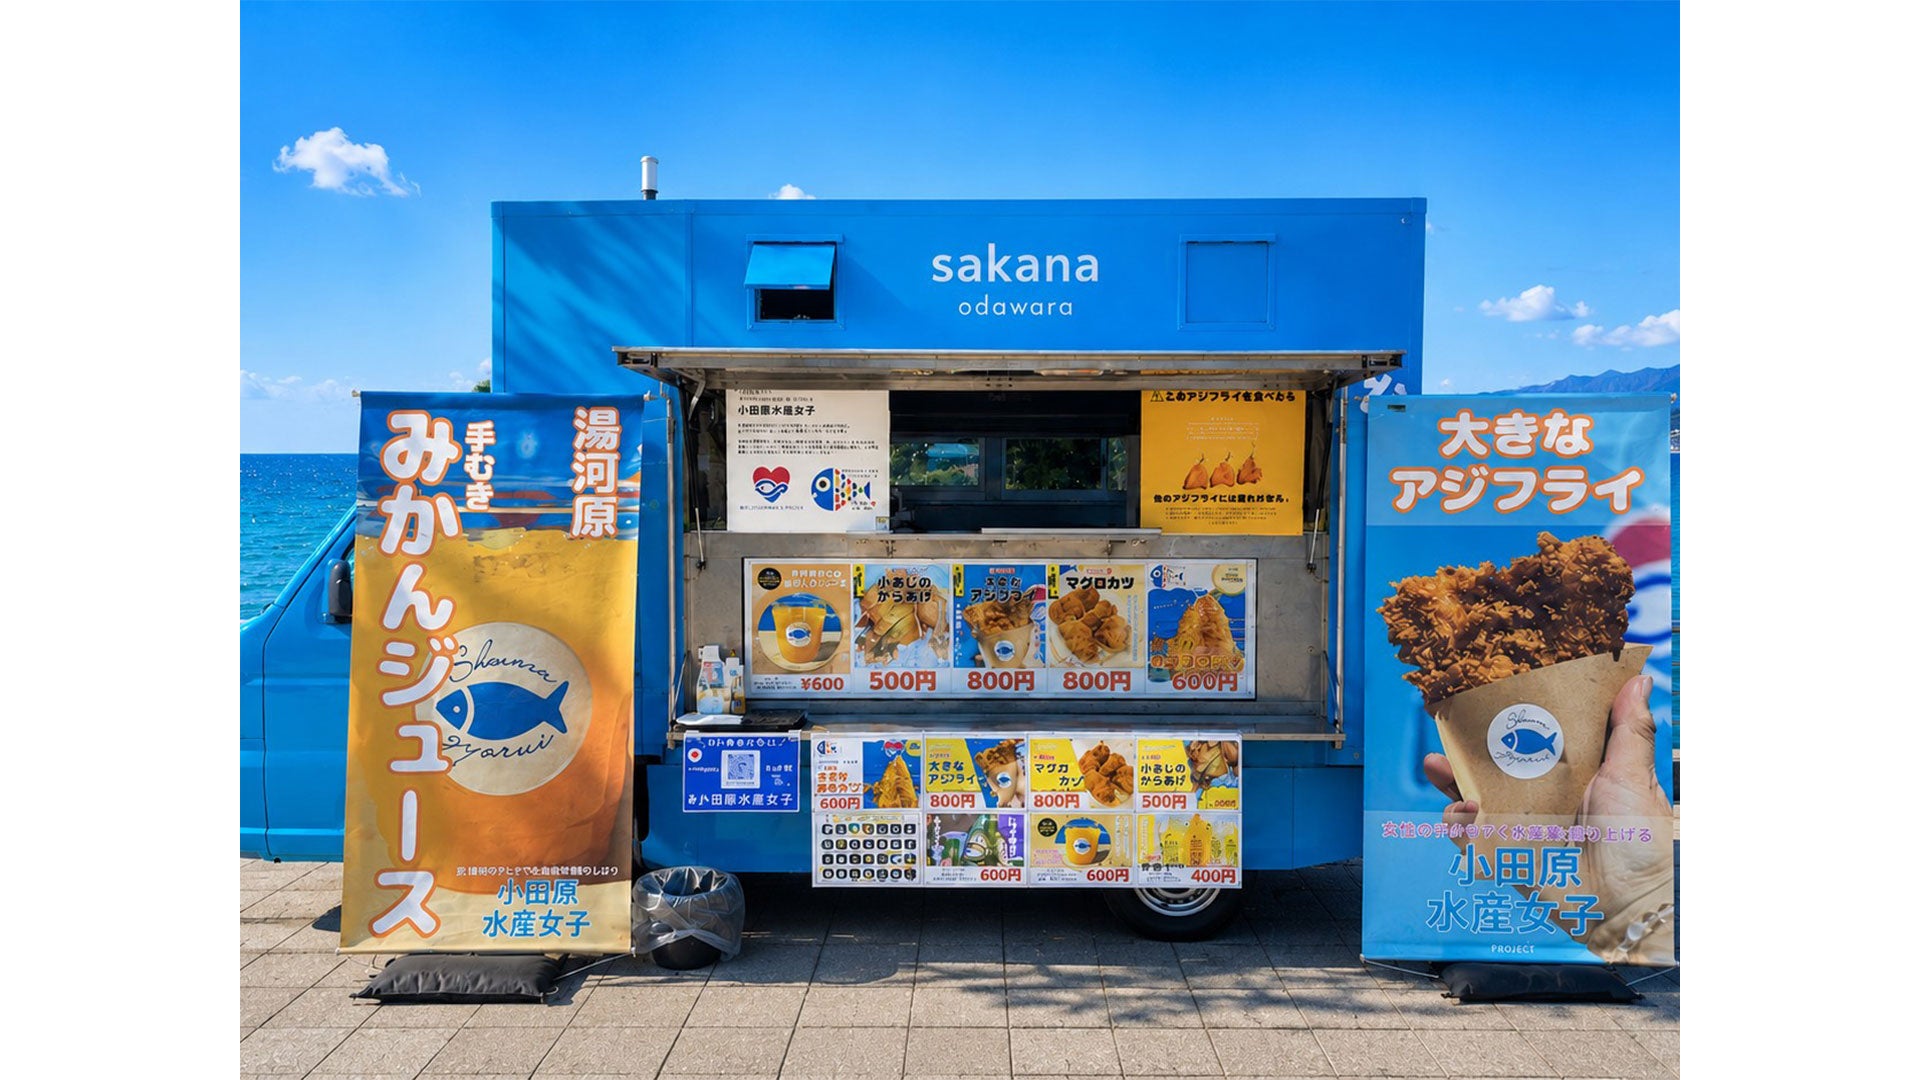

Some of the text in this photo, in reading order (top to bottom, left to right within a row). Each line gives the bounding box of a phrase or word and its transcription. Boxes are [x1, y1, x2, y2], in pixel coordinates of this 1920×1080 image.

[932, 243, 1099, 282] sakana
[958, 294, 1073, 316] odawara
[1437, 408, 1593, 458] 大きな
[465, 420, 496, 511] 手むき
[570, 405, 622, 539] 湯河原
[1389, 464, 1645, 514] アジフライ
[878, 576, 931, 589] 小あじの
[1066, 576, 1135, 590] マグロカツ
[877, 590, 932, 603] からあげ
[369, 410, 463, 938] みかんジュース
[801, 677, 844, 691] ¥600
[869, 671, 936, 691] 500円
[967, 671, 1035, 691] 800円
[1063, 671, 1131, 691] 800円
[1172, 672, 1238, 692] 600円
[820, 797, 860, 810] 600円
[930, 794, 975, 808] 800円
[1034, 794, 1080, 808] 800円
[1142, 794, 1186, 809] 500円
[980, 868, 1021, 881] 600円
[1087, 868, 1129, 882] 600円
[1191, 867, 1236, 883] 400円
[1448, 844, 1582, 888] 小田原
[497, 877, 579, 905] 小田原
[1426, 890, 1604, 936] 水産女子
[482, 909, 590, 938] 水産女子
[1491, 944, 1535, 954] PROJECT
